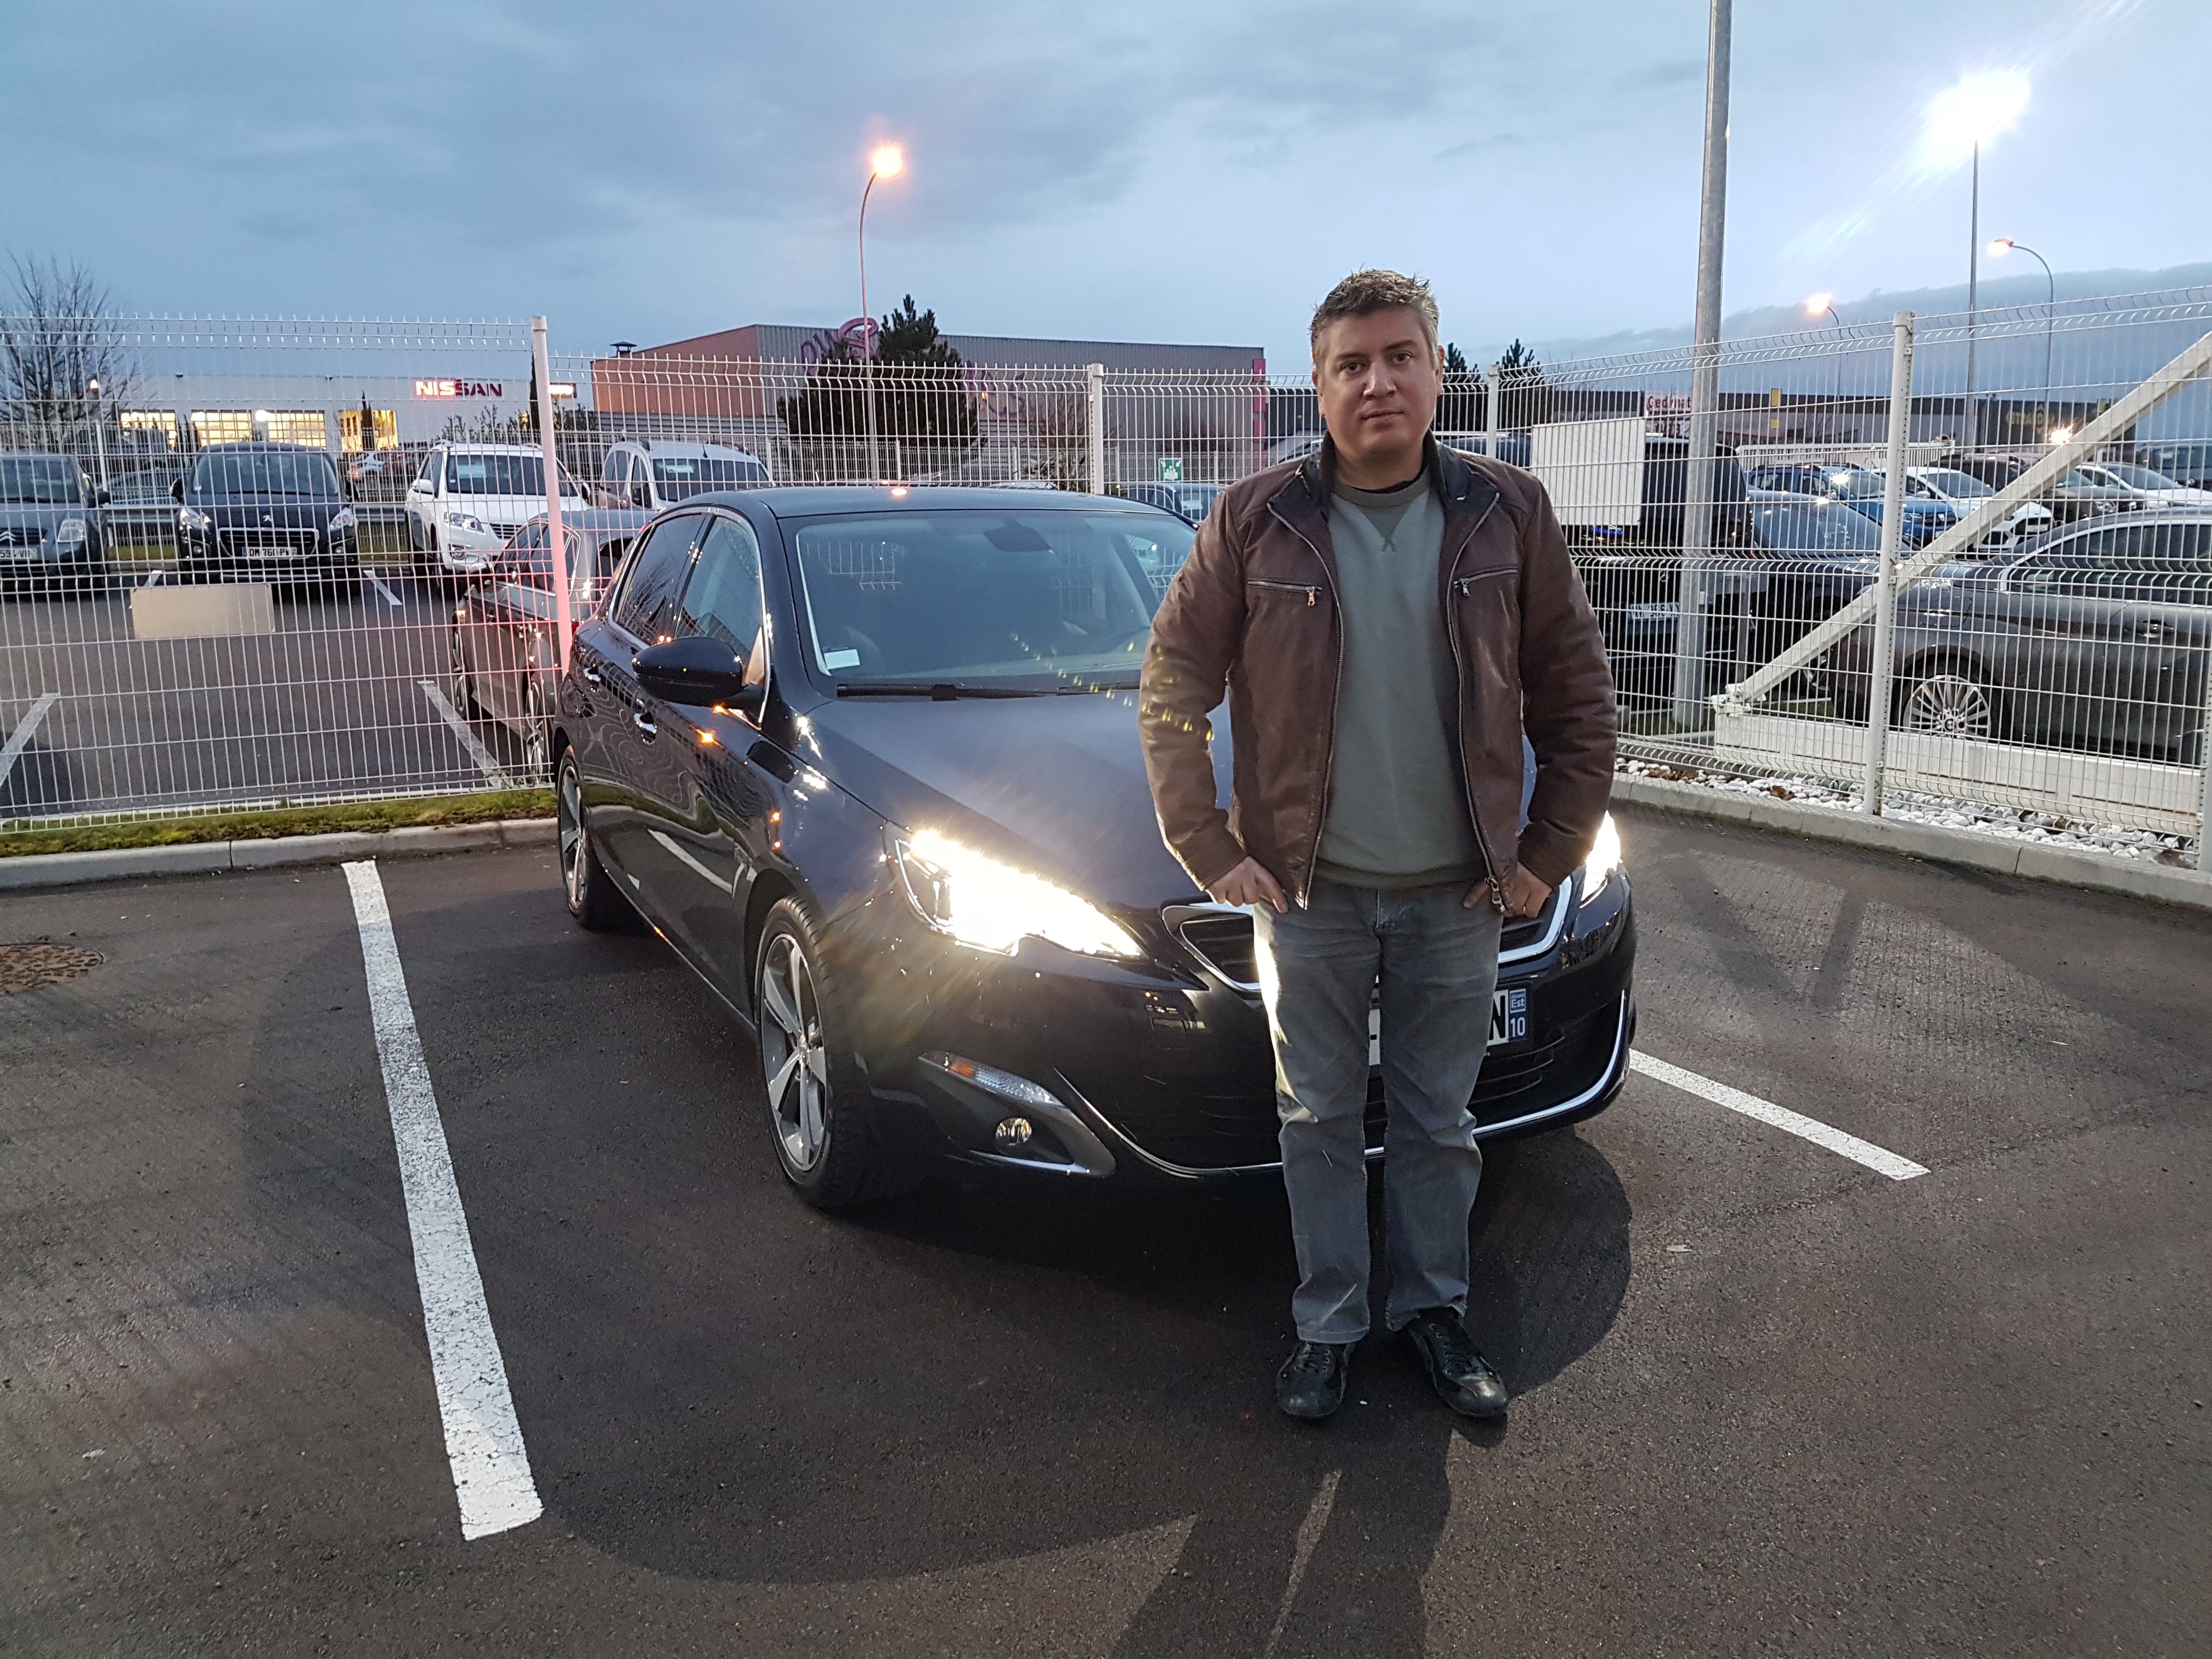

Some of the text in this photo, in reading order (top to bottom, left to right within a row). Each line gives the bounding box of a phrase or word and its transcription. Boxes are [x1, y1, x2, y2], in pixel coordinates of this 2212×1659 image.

[415, 380, 502, 397] NISSAN
[1511, 998, 1525, 1008] Est
[1510, 1017, 1526, 1037] 10
